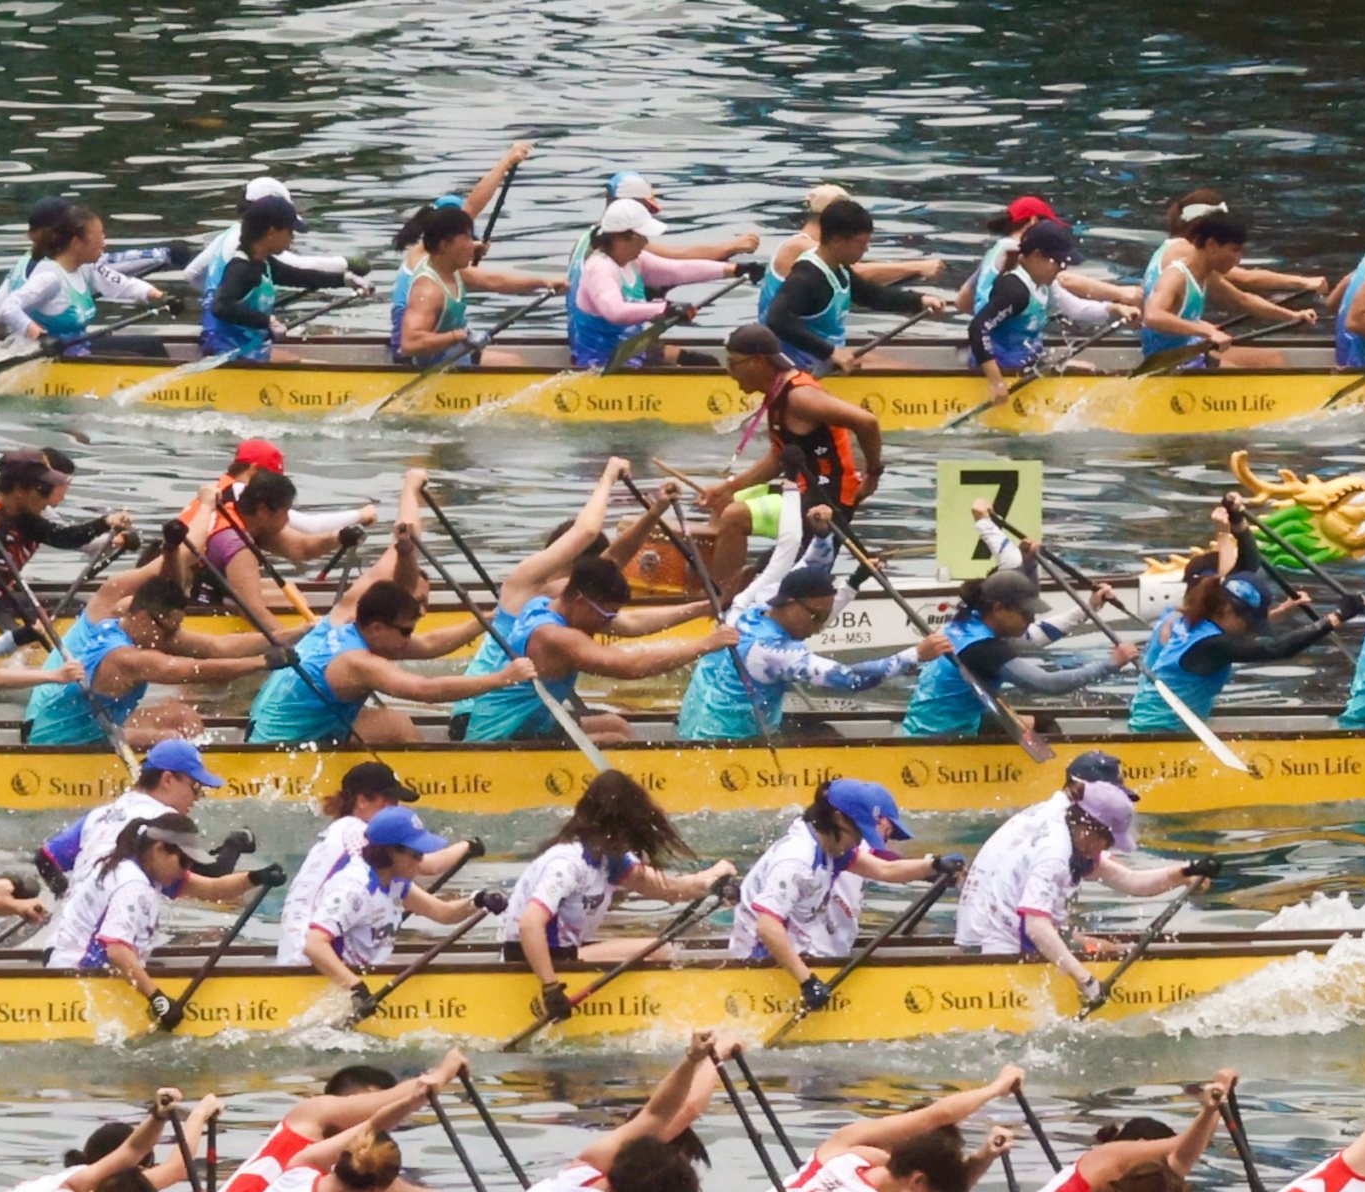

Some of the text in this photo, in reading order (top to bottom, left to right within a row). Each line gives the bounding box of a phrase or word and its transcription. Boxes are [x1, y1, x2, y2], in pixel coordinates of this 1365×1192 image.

[184, 387, 217, 402] Life
[289, 391, 352, 406] Sun Lif
[435, 393, 471, 408] Sun
[587, 395, 662, 412] Sun Life
[1201, 395, 1276, 411] Sun Life
[891, 399, 929, 415] Sun
[960, 470, 1019, 560] 7
[821, 631, 871, 644] 24-M53
[938, 766, 1022, 784] Sun Life
[1160, 760, 1198, 778] Life
[1281, 758, 1362, 776] Sun Life
[405, 776, 492, 795] Sun Life
[757, 767, 843, 786] Sun Life
[48, 777, 92, 795] Sun
[619, 996, 661, 1014] Life
[941, 992, 984, 1008] Sun
[1113, 988, 1151, 1004] Sun
[185, 1000, 278, 1020] Sun Life
[375, 998, 466, 1019] Sun Life
